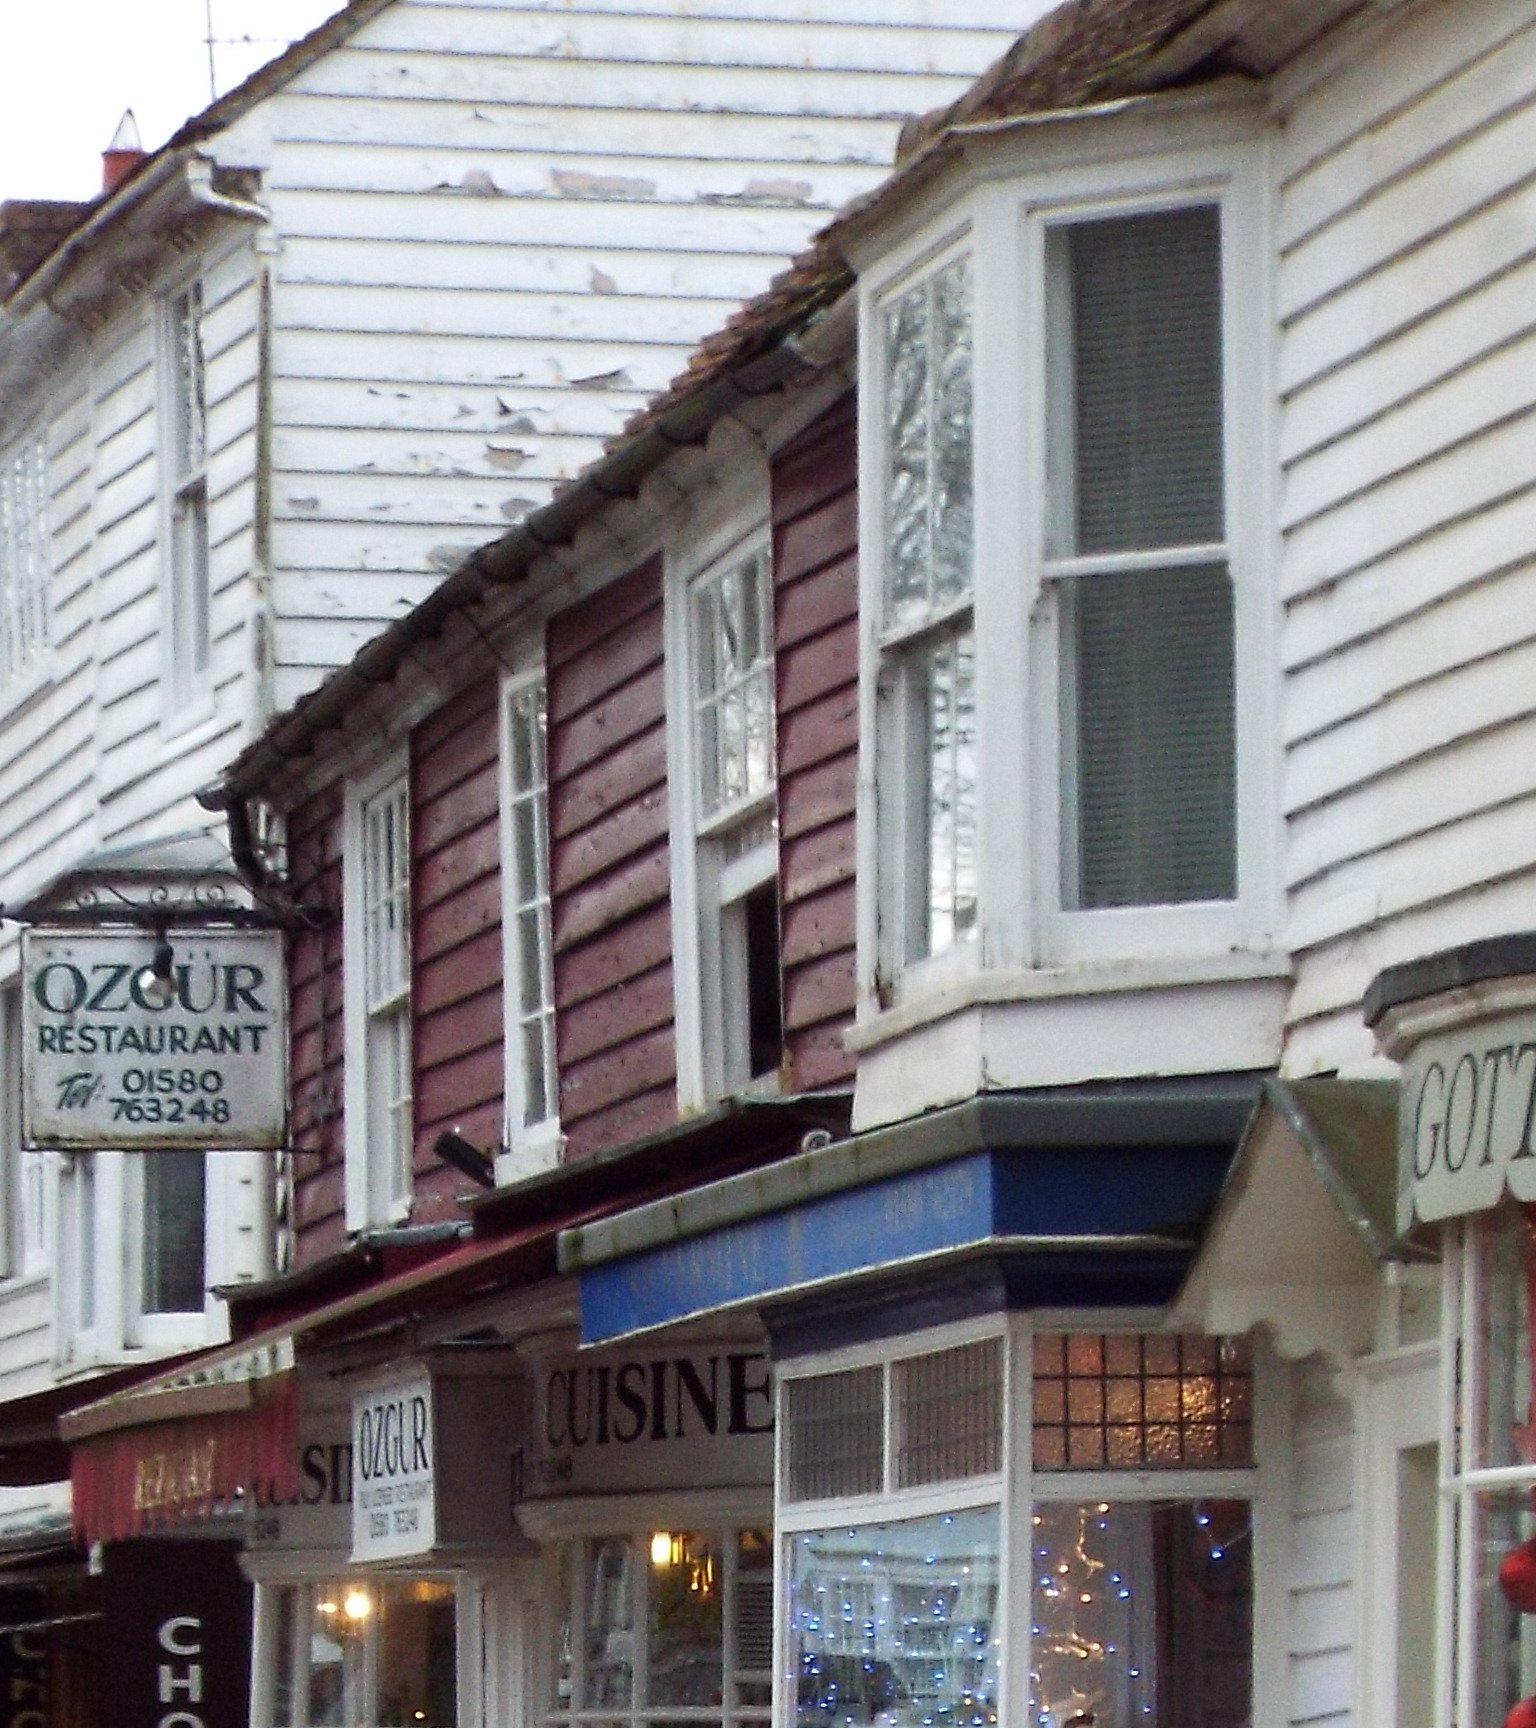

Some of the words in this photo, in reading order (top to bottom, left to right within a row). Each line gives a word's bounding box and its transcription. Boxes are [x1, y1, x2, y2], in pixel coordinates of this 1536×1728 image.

[38, 1024, 268, 1054] RESTAURANT
[122, 1069, 223, 1093] 01580
[109, 1098, 230, 1123] 763248
[545, 1352, 775, 1448] CUISINE
